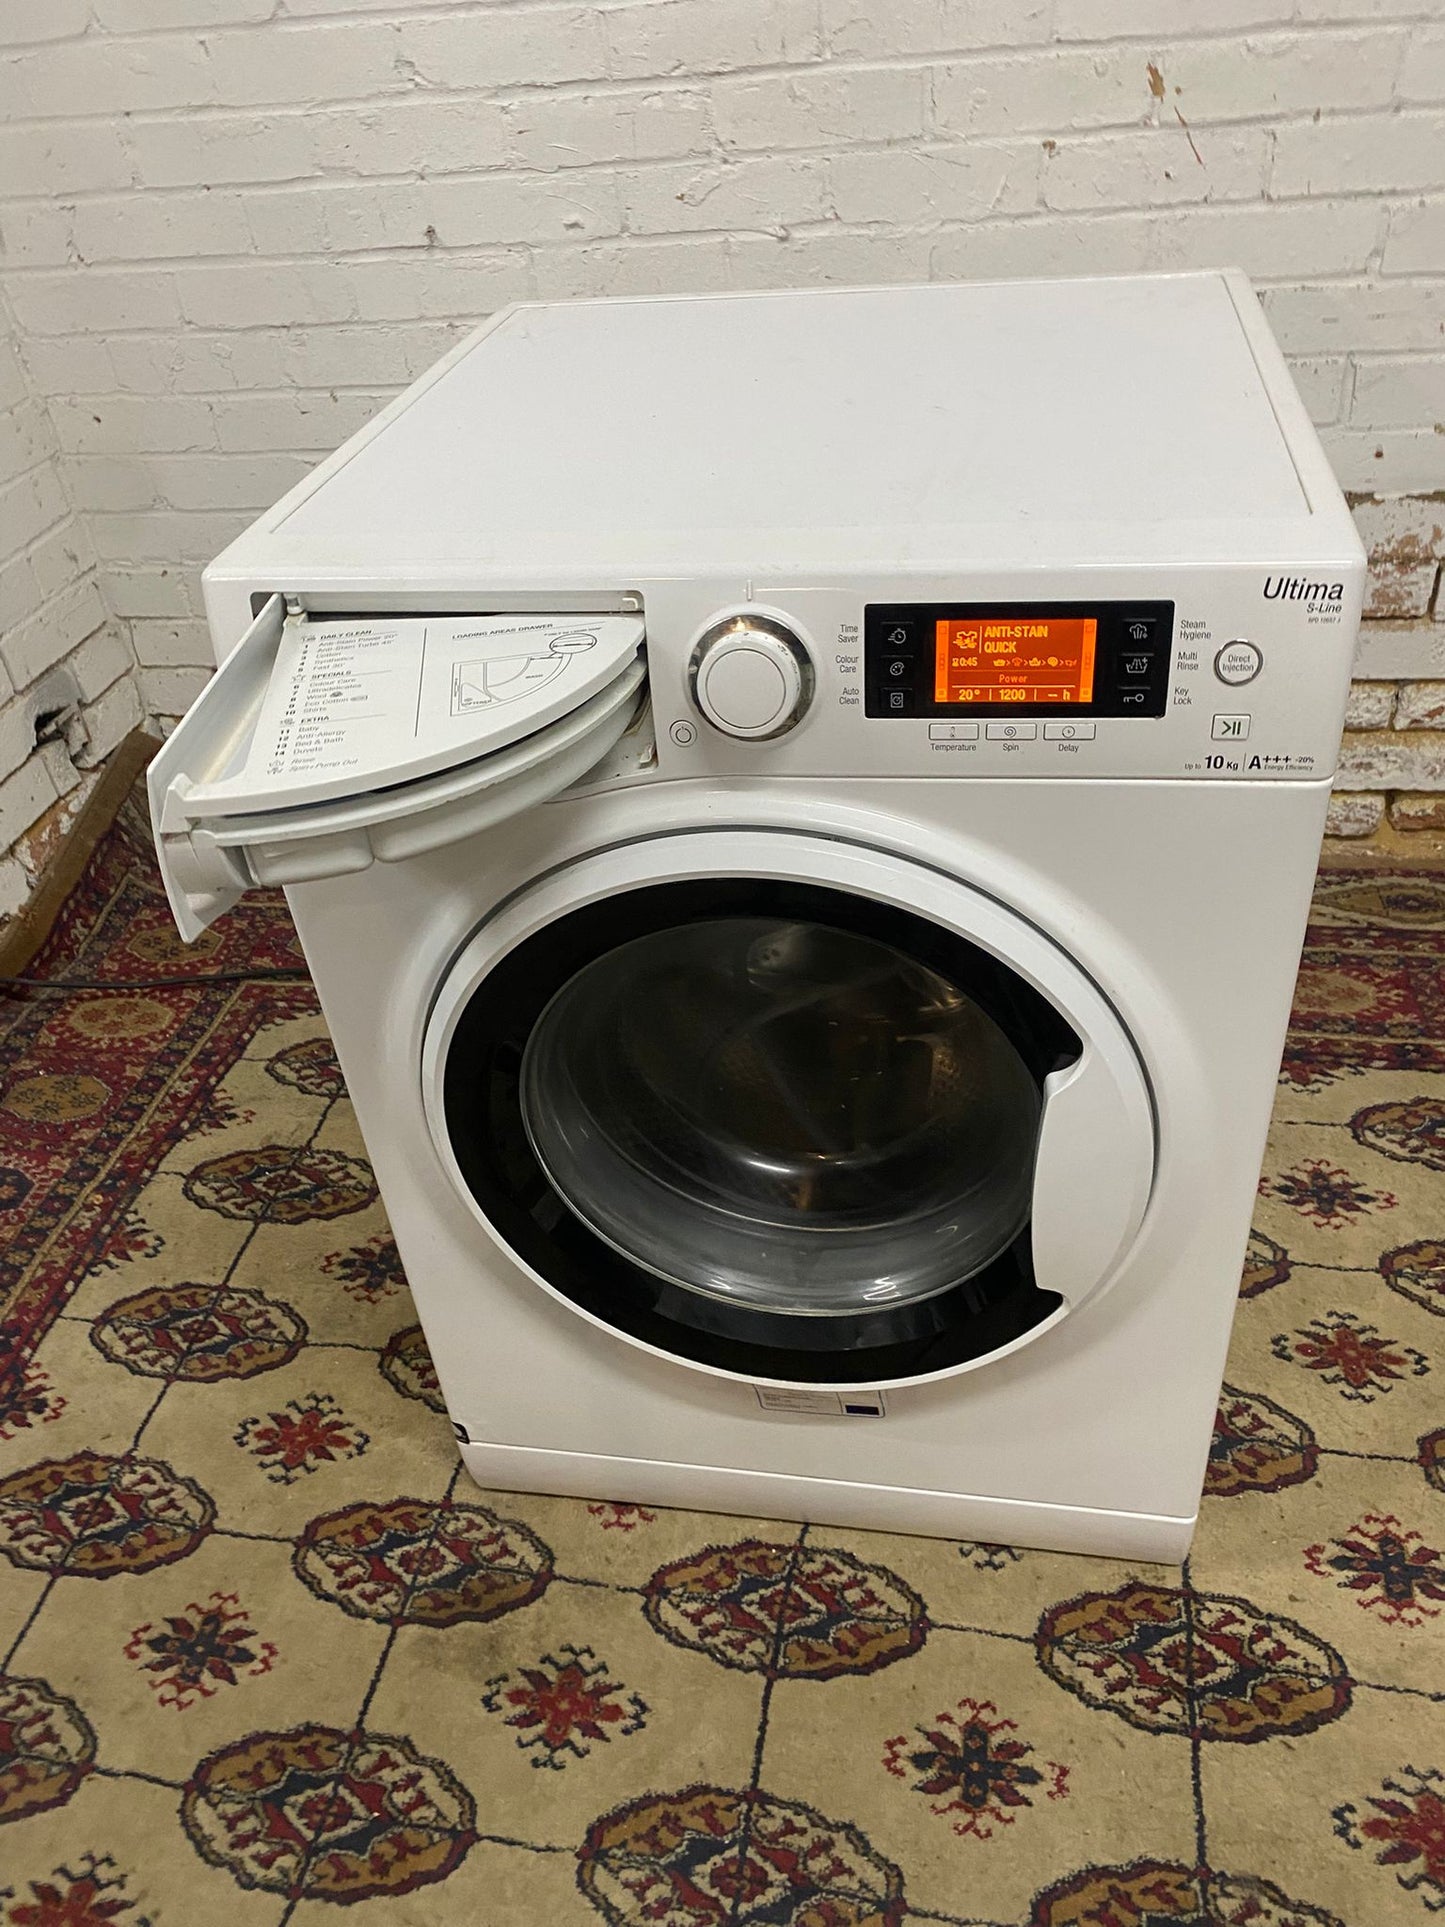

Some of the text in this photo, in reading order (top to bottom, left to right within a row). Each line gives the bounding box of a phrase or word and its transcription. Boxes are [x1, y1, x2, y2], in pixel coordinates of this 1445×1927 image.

[1264, 576, 1343, 600] Ultima
[1307, 602, 1342, 613] S-Line
[840, 624, 858, 632] Time
[1180, 619, 1206, 629] Steam
[452, 631, 487, 639] LOADING
[984, 625, 1048, 637] ANTI-STAIN
[1180, 631, 1212, 640] Hygiene
[838, 634, 858, 643] Saver
[984, 641, 1016, 653] QUICK
[835, 655, 859, 663] Colour
[1178, 652, 1197, 660] Multi
[960, 657, 978, 667] 0:45
[1177, 661, 1198, 670] Rinse
[1223, 664, 1254, 673] Injection
[312, 671, 352, 679] SPECIALS
[999, 674, 1027, 683] Power
[959, 688, 980, 700] 20°
[999, 689, 1026, 700] 1200
[1174, 686, 1188, 696] Key
[1174, 696, 1192, 705] Lock
[1058, 743, 1079, 752] Delay
[1205, 755, 1224, 769] 10
[1227, 761, 1238, 770] Kg
[1248, 755, 1291, 769] A+++
